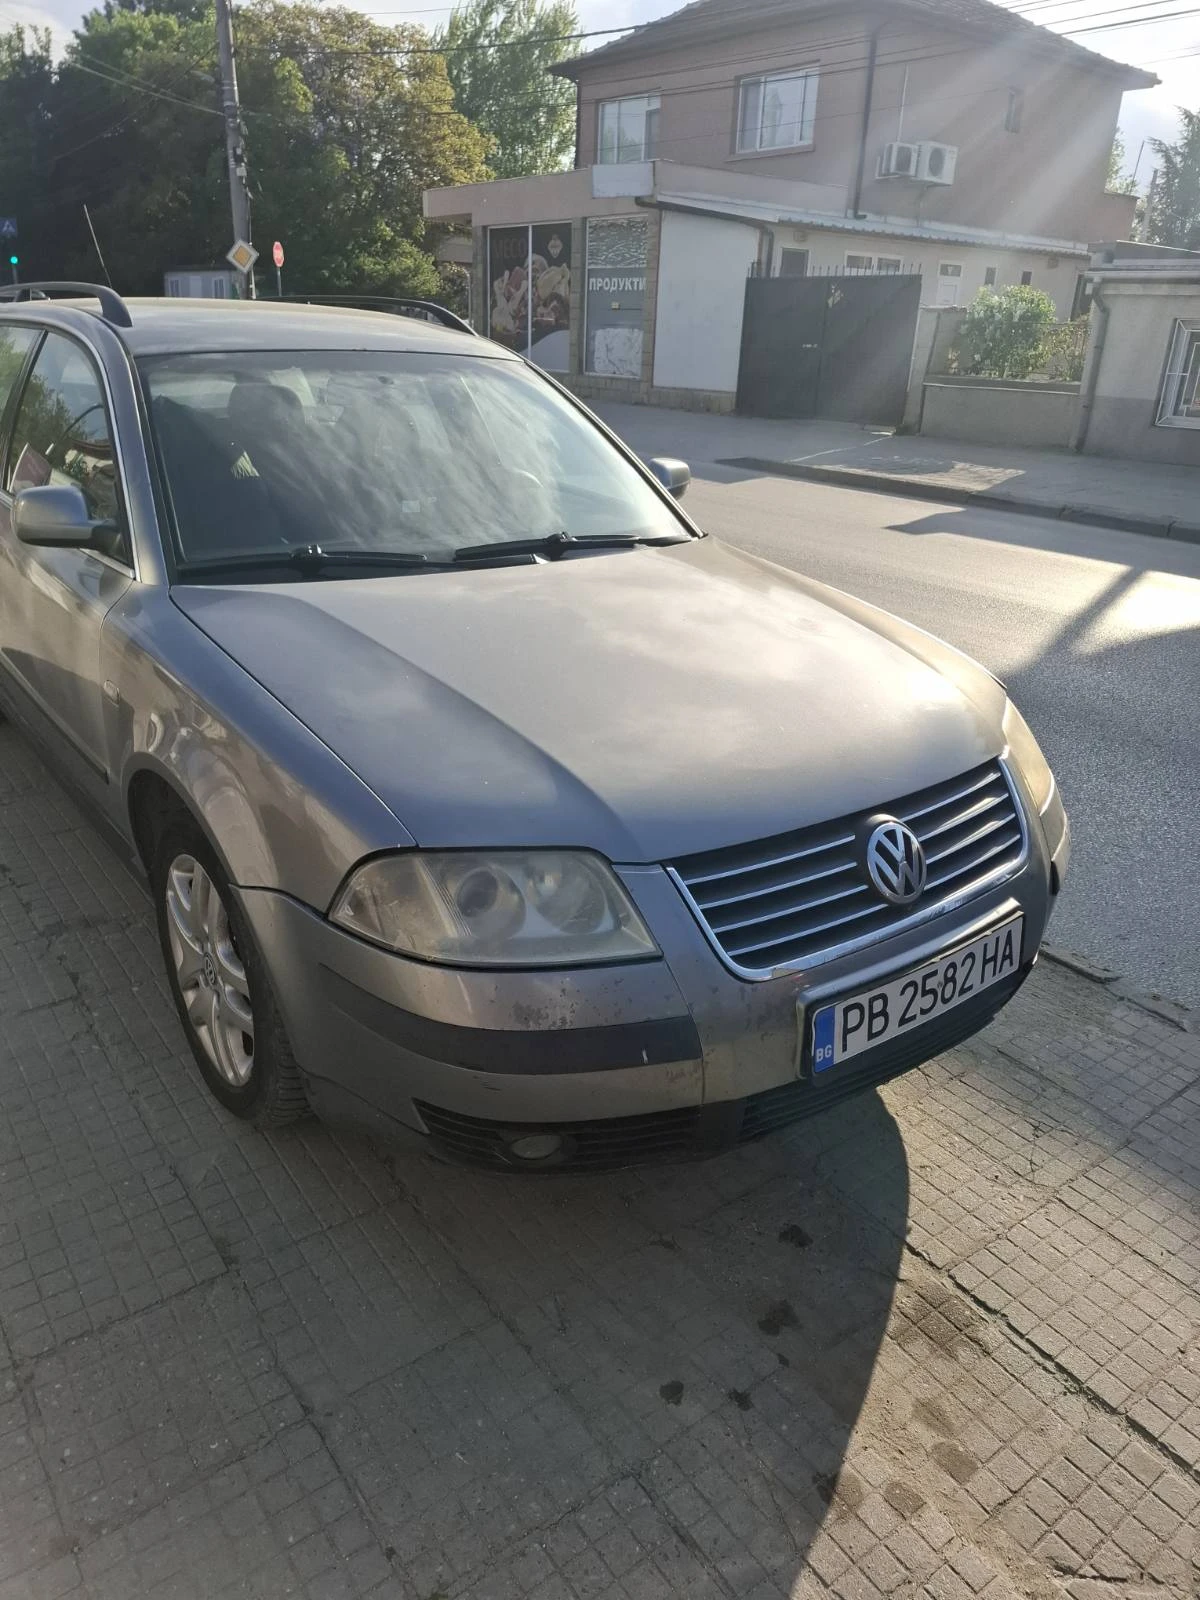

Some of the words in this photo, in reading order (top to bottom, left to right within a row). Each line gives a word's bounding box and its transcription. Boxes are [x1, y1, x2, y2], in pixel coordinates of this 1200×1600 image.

[589, 277, 647, 292] ПРОДУКТИ
[842, 992, 889, 1053] PB
[898, 952, 976, 1028] 2582
[980, 929, 1014, 985] HA
[816, 1044, 832, 1062] BG
